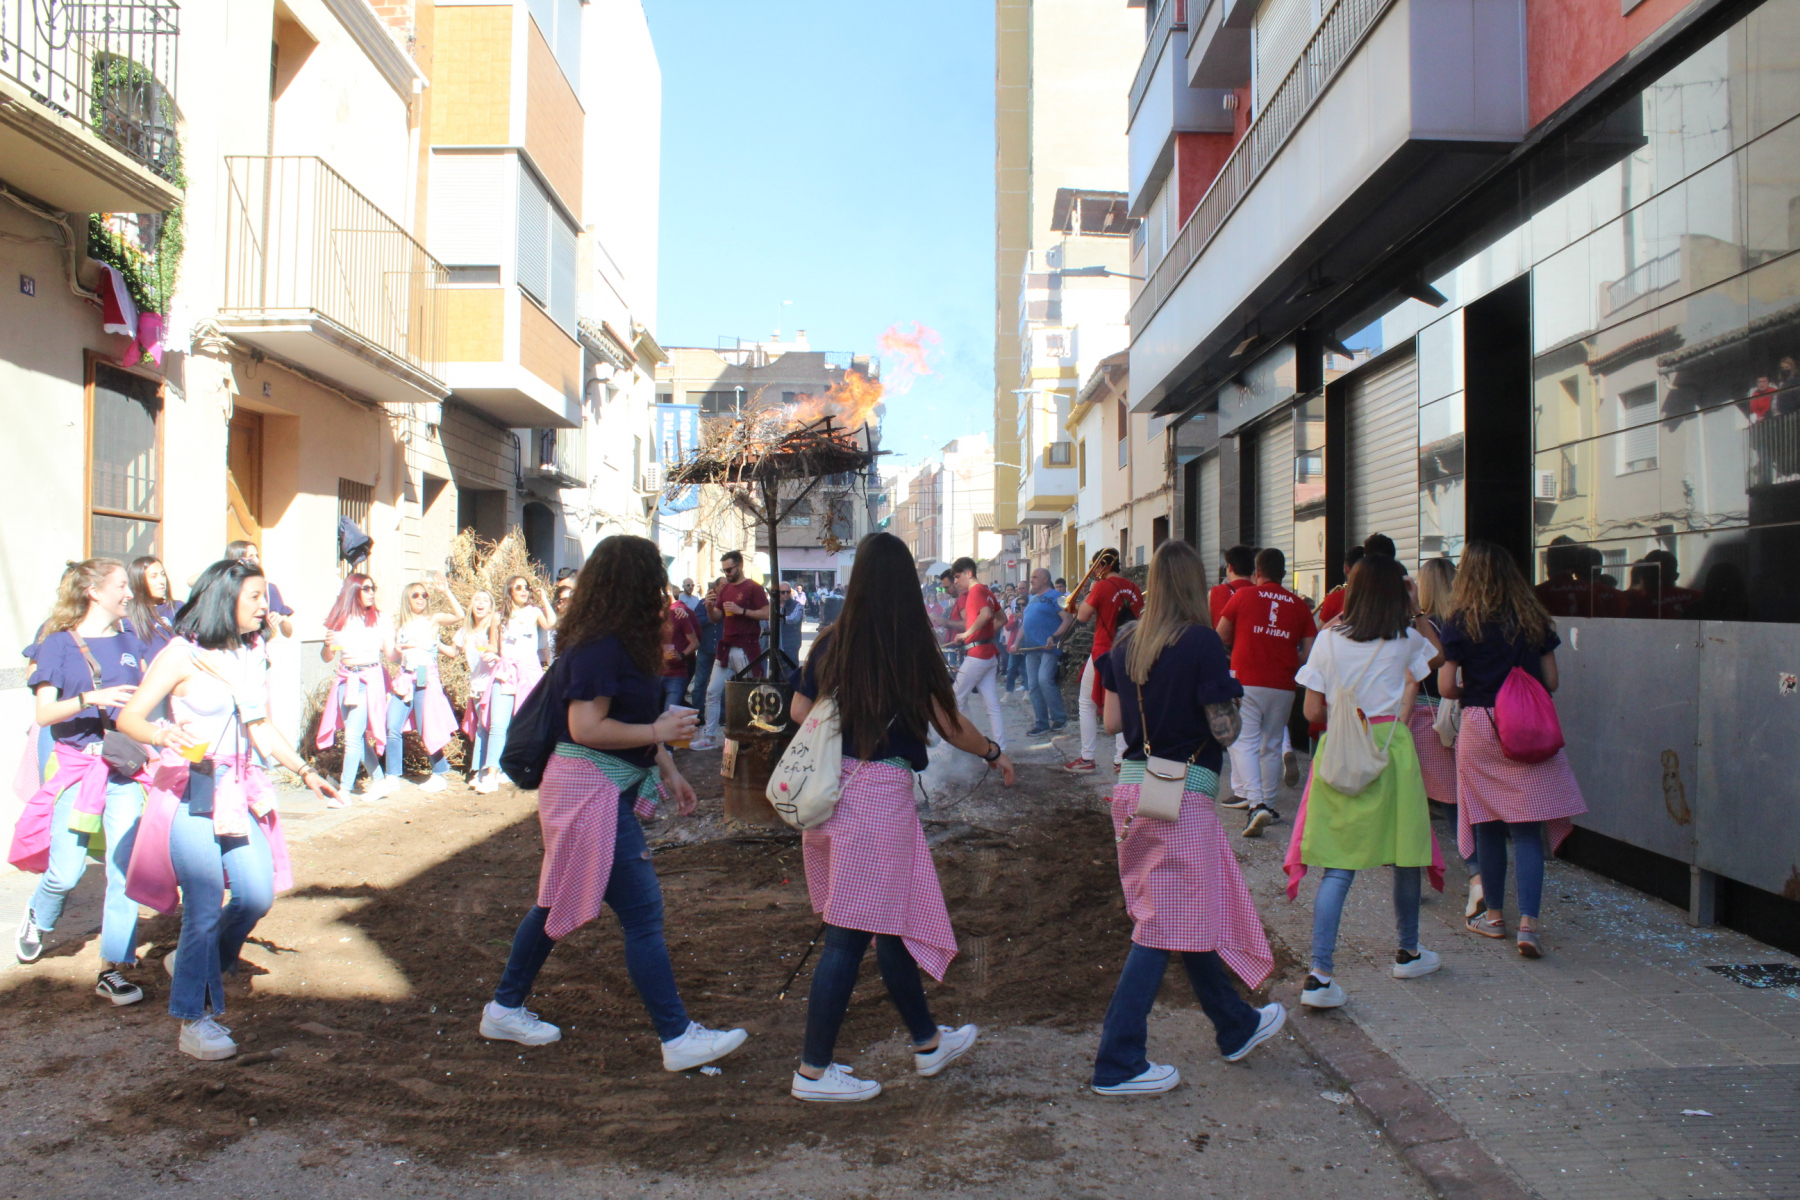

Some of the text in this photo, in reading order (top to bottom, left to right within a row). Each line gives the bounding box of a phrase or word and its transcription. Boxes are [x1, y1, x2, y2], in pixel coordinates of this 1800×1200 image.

[1258, 590, 1295, 604] XARANGA
[1253, 625, 1264, 634] EN
[751, 691, 781, 716] 89
